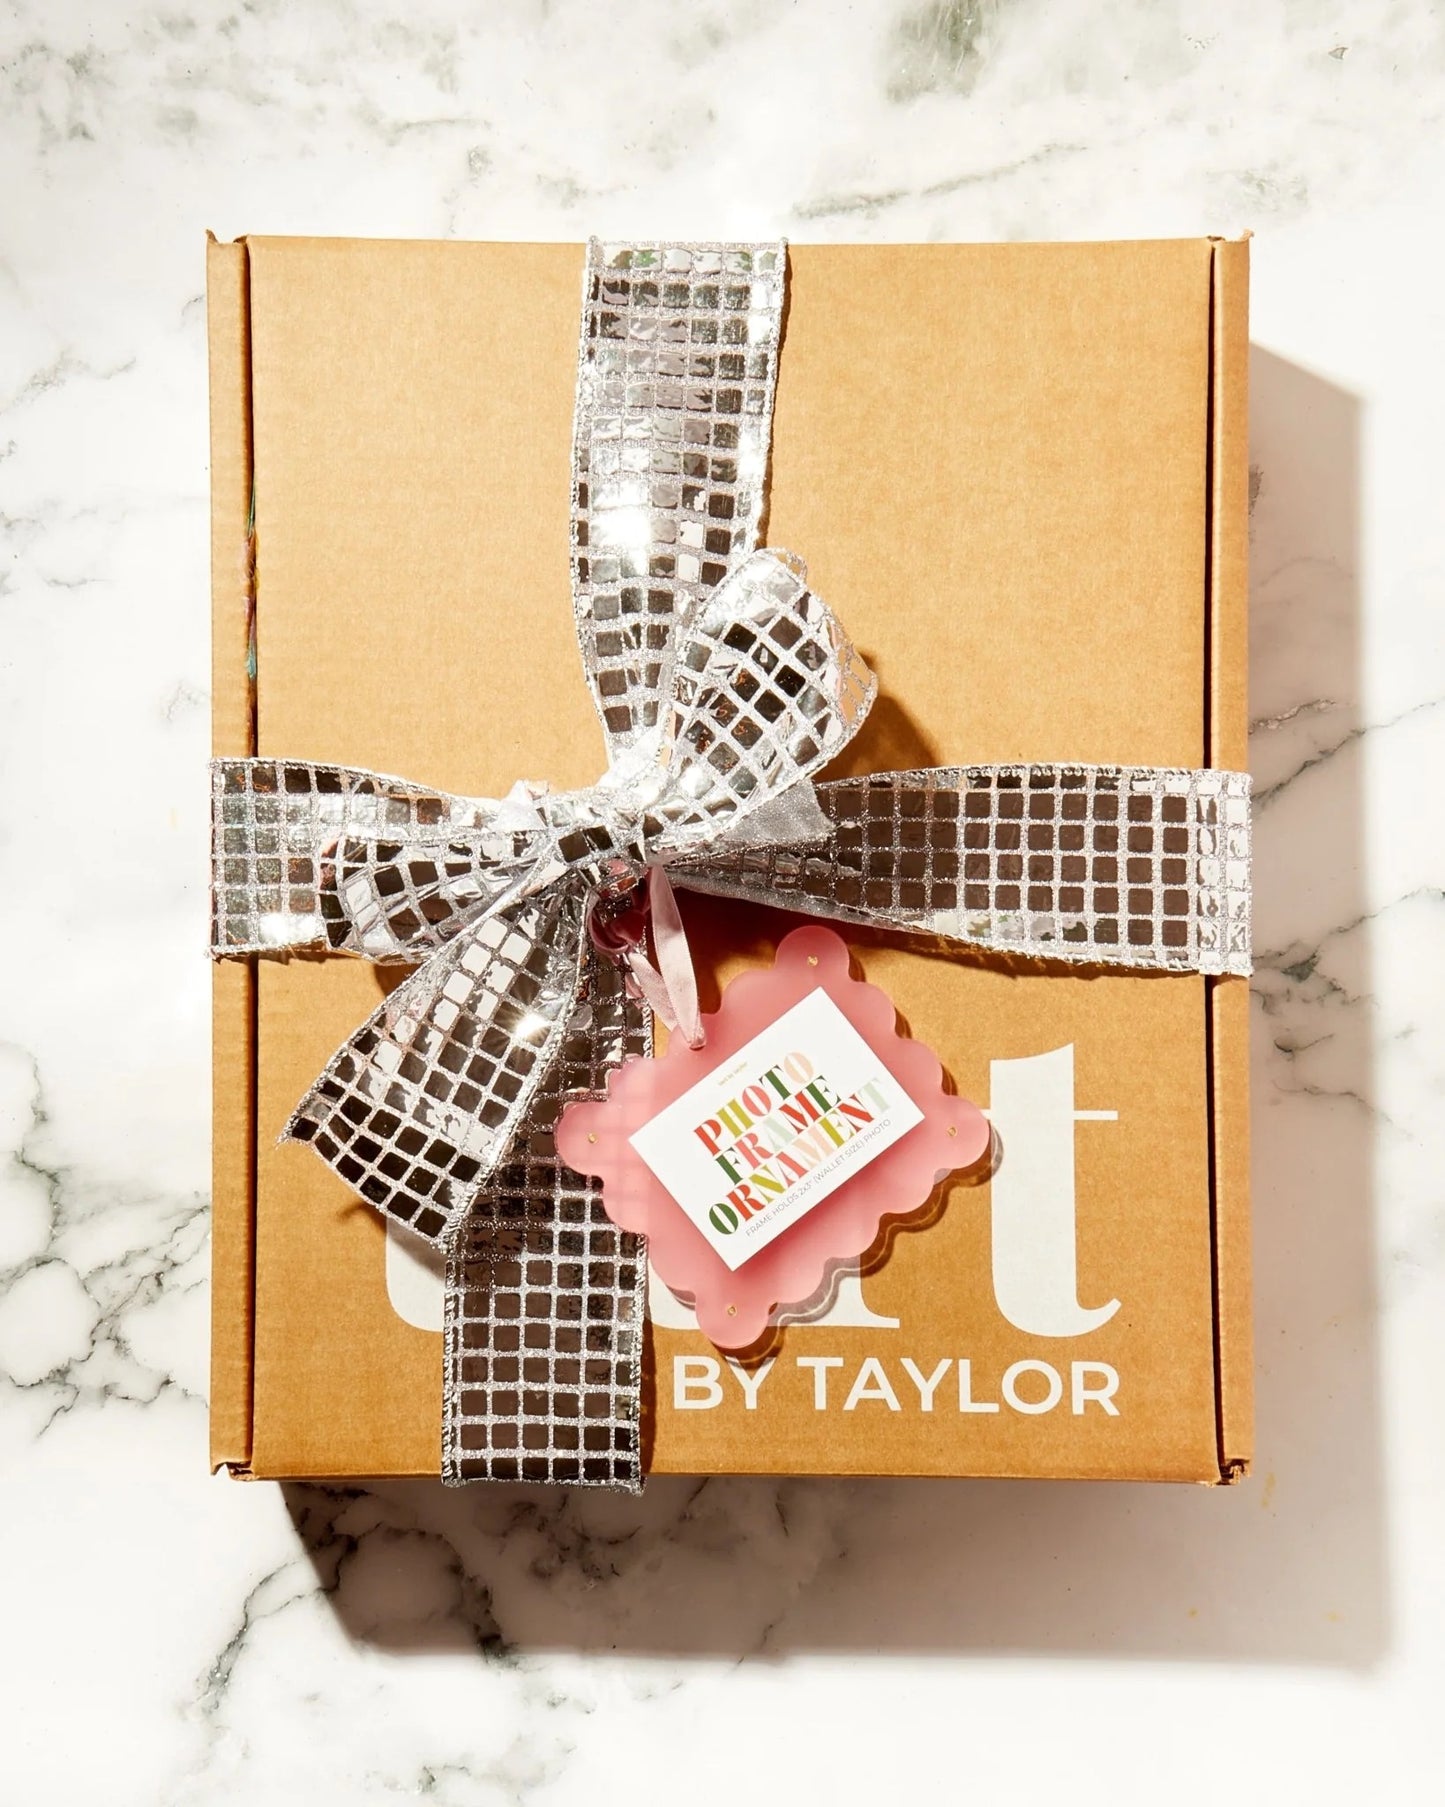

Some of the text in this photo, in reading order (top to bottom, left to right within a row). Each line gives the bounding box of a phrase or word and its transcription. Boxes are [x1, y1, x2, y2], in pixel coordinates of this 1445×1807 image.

[694, 1052, 814, 1156] PHOTO
[709, 1076, 890, 1235] ORNAMENT
[715, 1075, 841, 1185] FRAME
[745, 1213, 773, 1237] FRAME
[773, 1192, 799, 1216] HOLDS
[863, 1118, 892, 1143] PHOTO
[673, 1355, 1120, 1416] BY TAYLOR
